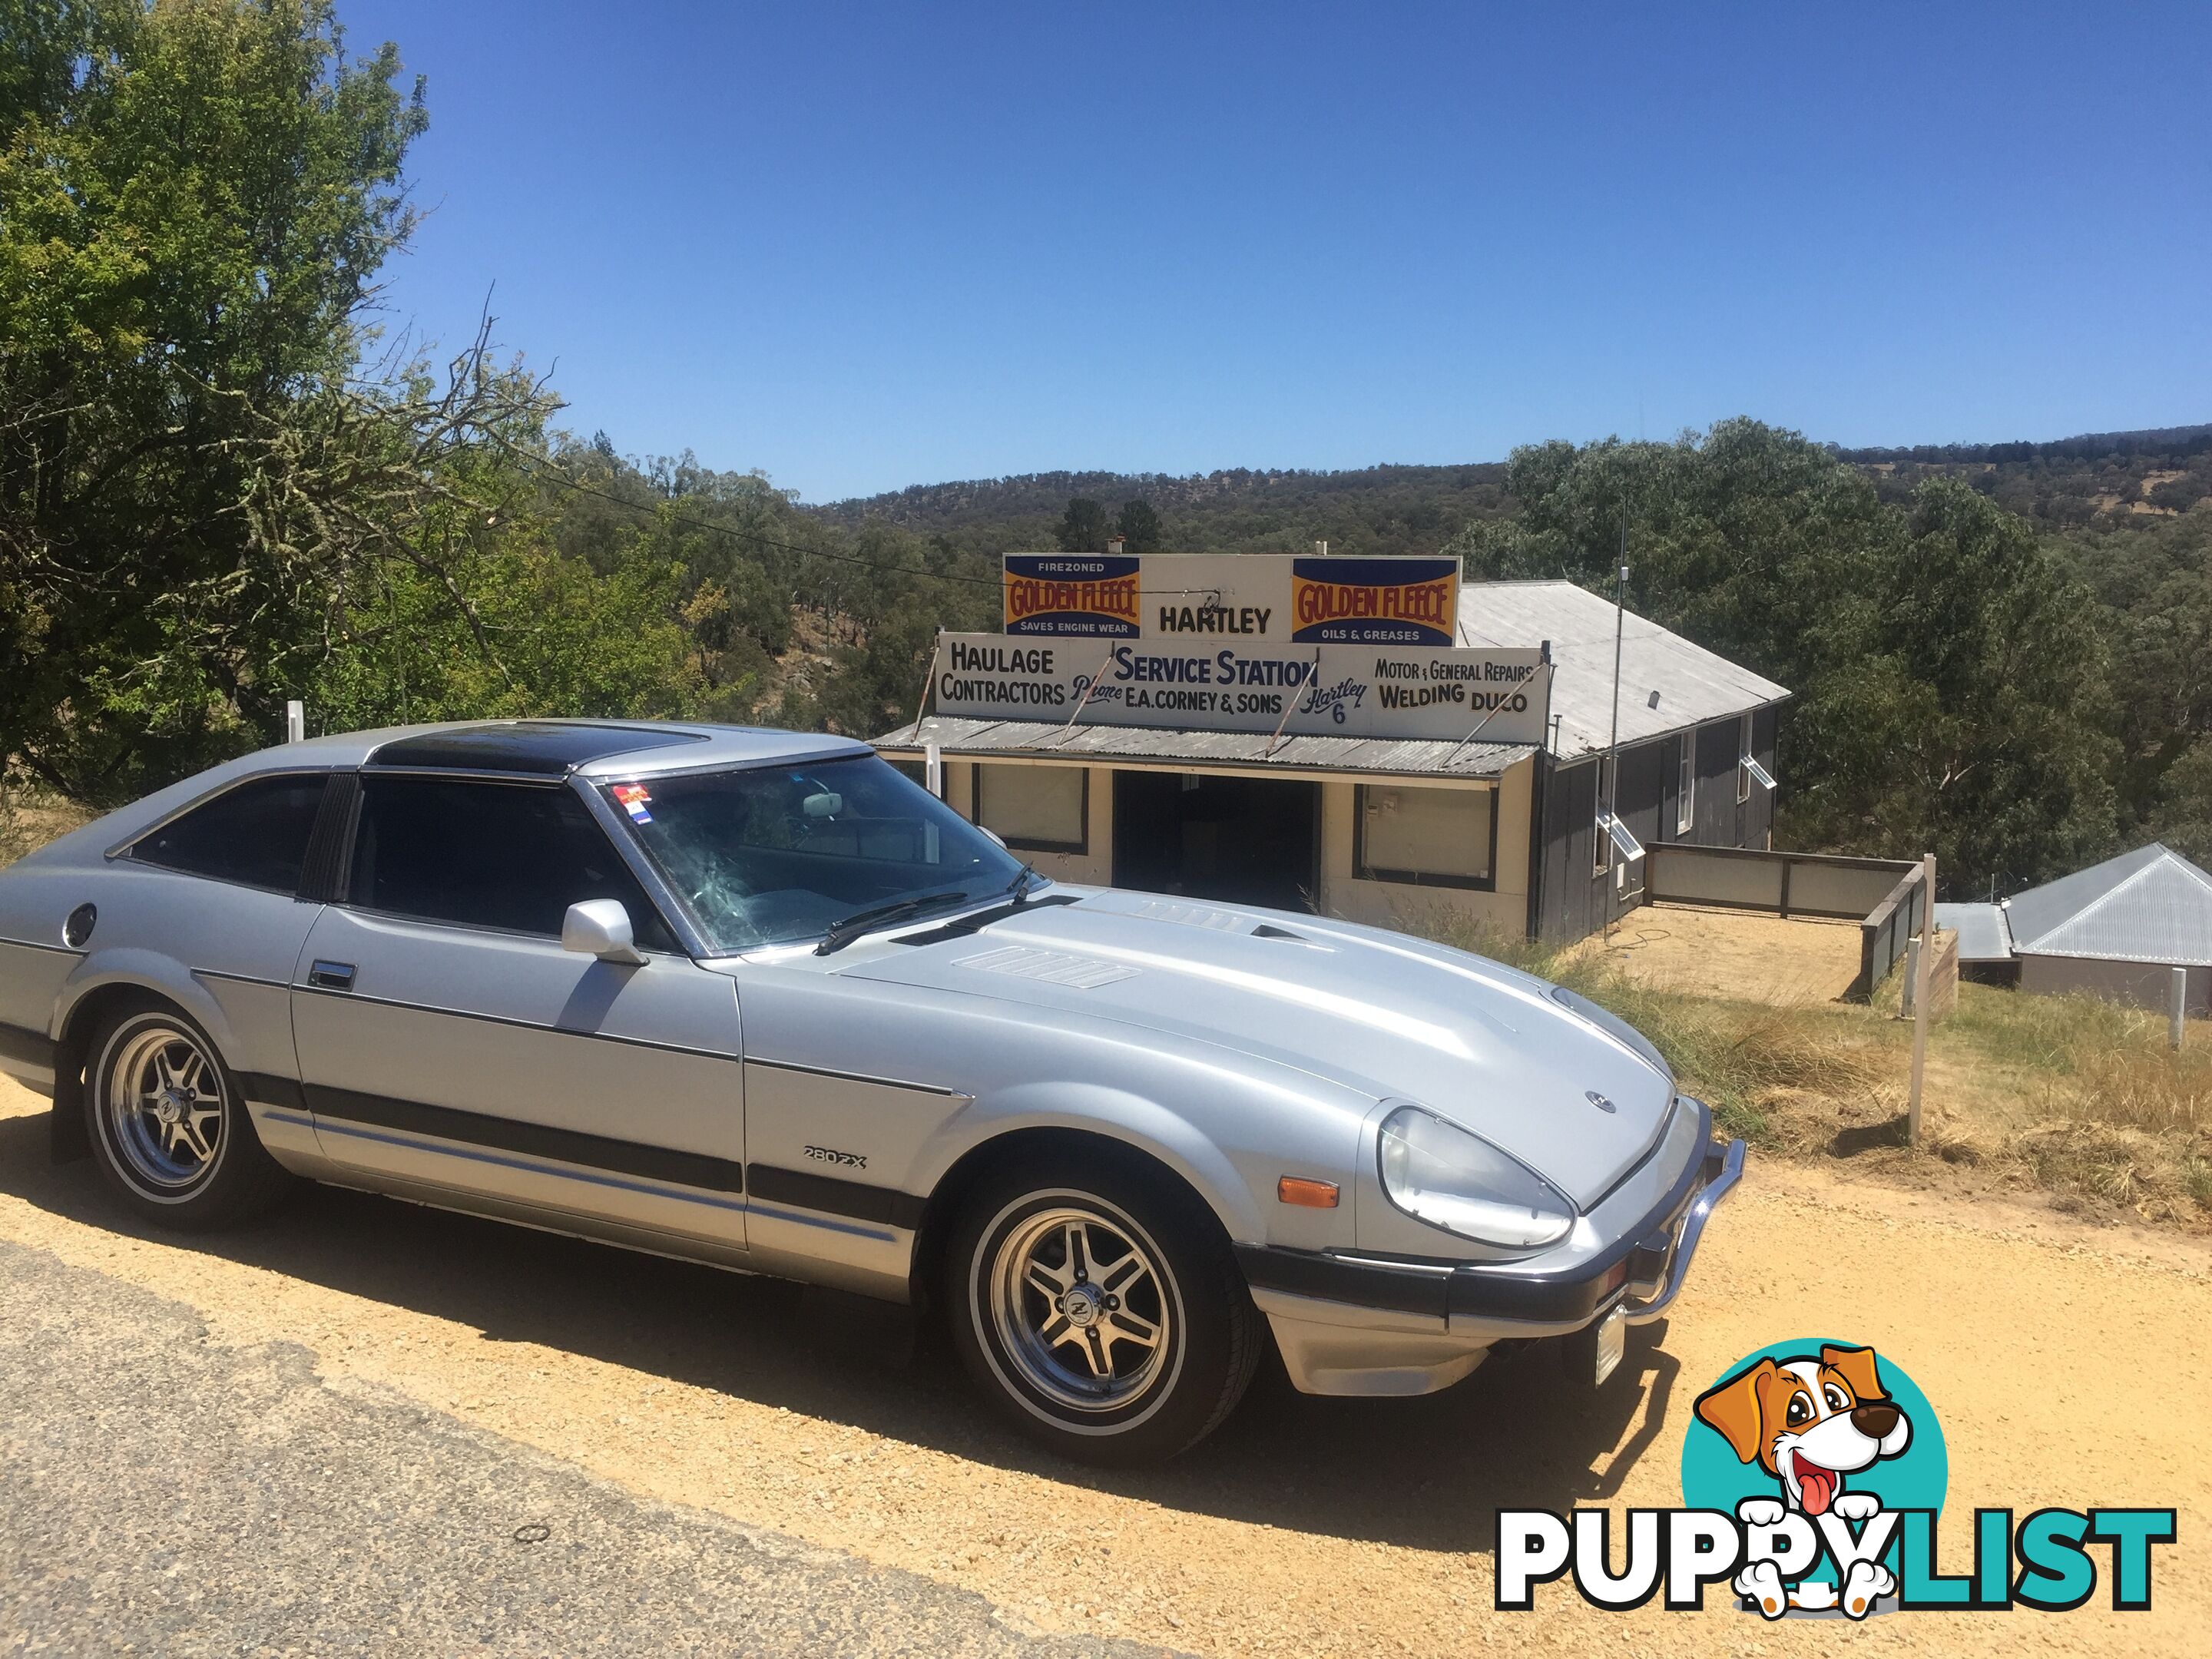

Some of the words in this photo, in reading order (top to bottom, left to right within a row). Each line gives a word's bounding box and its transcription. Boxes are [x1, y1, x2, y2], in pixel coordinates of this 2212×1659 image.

[1038, 563, 1104, 572] FIREZONED
[1010, 580, 1078, 616] GOLDEN
[1081, 579, 1137, 618] FLEECE
[1298, 584, 1378, 624] GOLDEN
[1382, 584, 1448, 625] FLEECE
[1020, 621, 1054, 631] SAVES
[1058, 623, 1095, 632] ENGINE
[1099, 624, 1128, 633] WEAR
[1160, 607, 1271, 634] HARTLEY
[1321, 629, 1346, 639] OILS
[1350, 630, 1359, 640] &
[1363, 631, 1419, 641] GREASES
[951, 642, 1054, 674] HAULAGE
[1114, 646, 1211, 684] SERVICE
[1217, 651, 1318, 687] STATION
[1375, 658, 1420, 679] MOTOR
[1430, 660, 1482, 681] GENERAL
[941, 673, 1065, 706] CONTRACTORS
[1300, 677, 1367, 714] Hartley
[1379, 683, 1465, 709] WELDING
[1471, 692, 1528, 713] DUCO
[1220, 693, 1234, 715] &
[1237, 693, 1283, 714] SONS
[1333, 703, 1346, 724] 6
[803, 1145, 867, 1169] 280ZX
